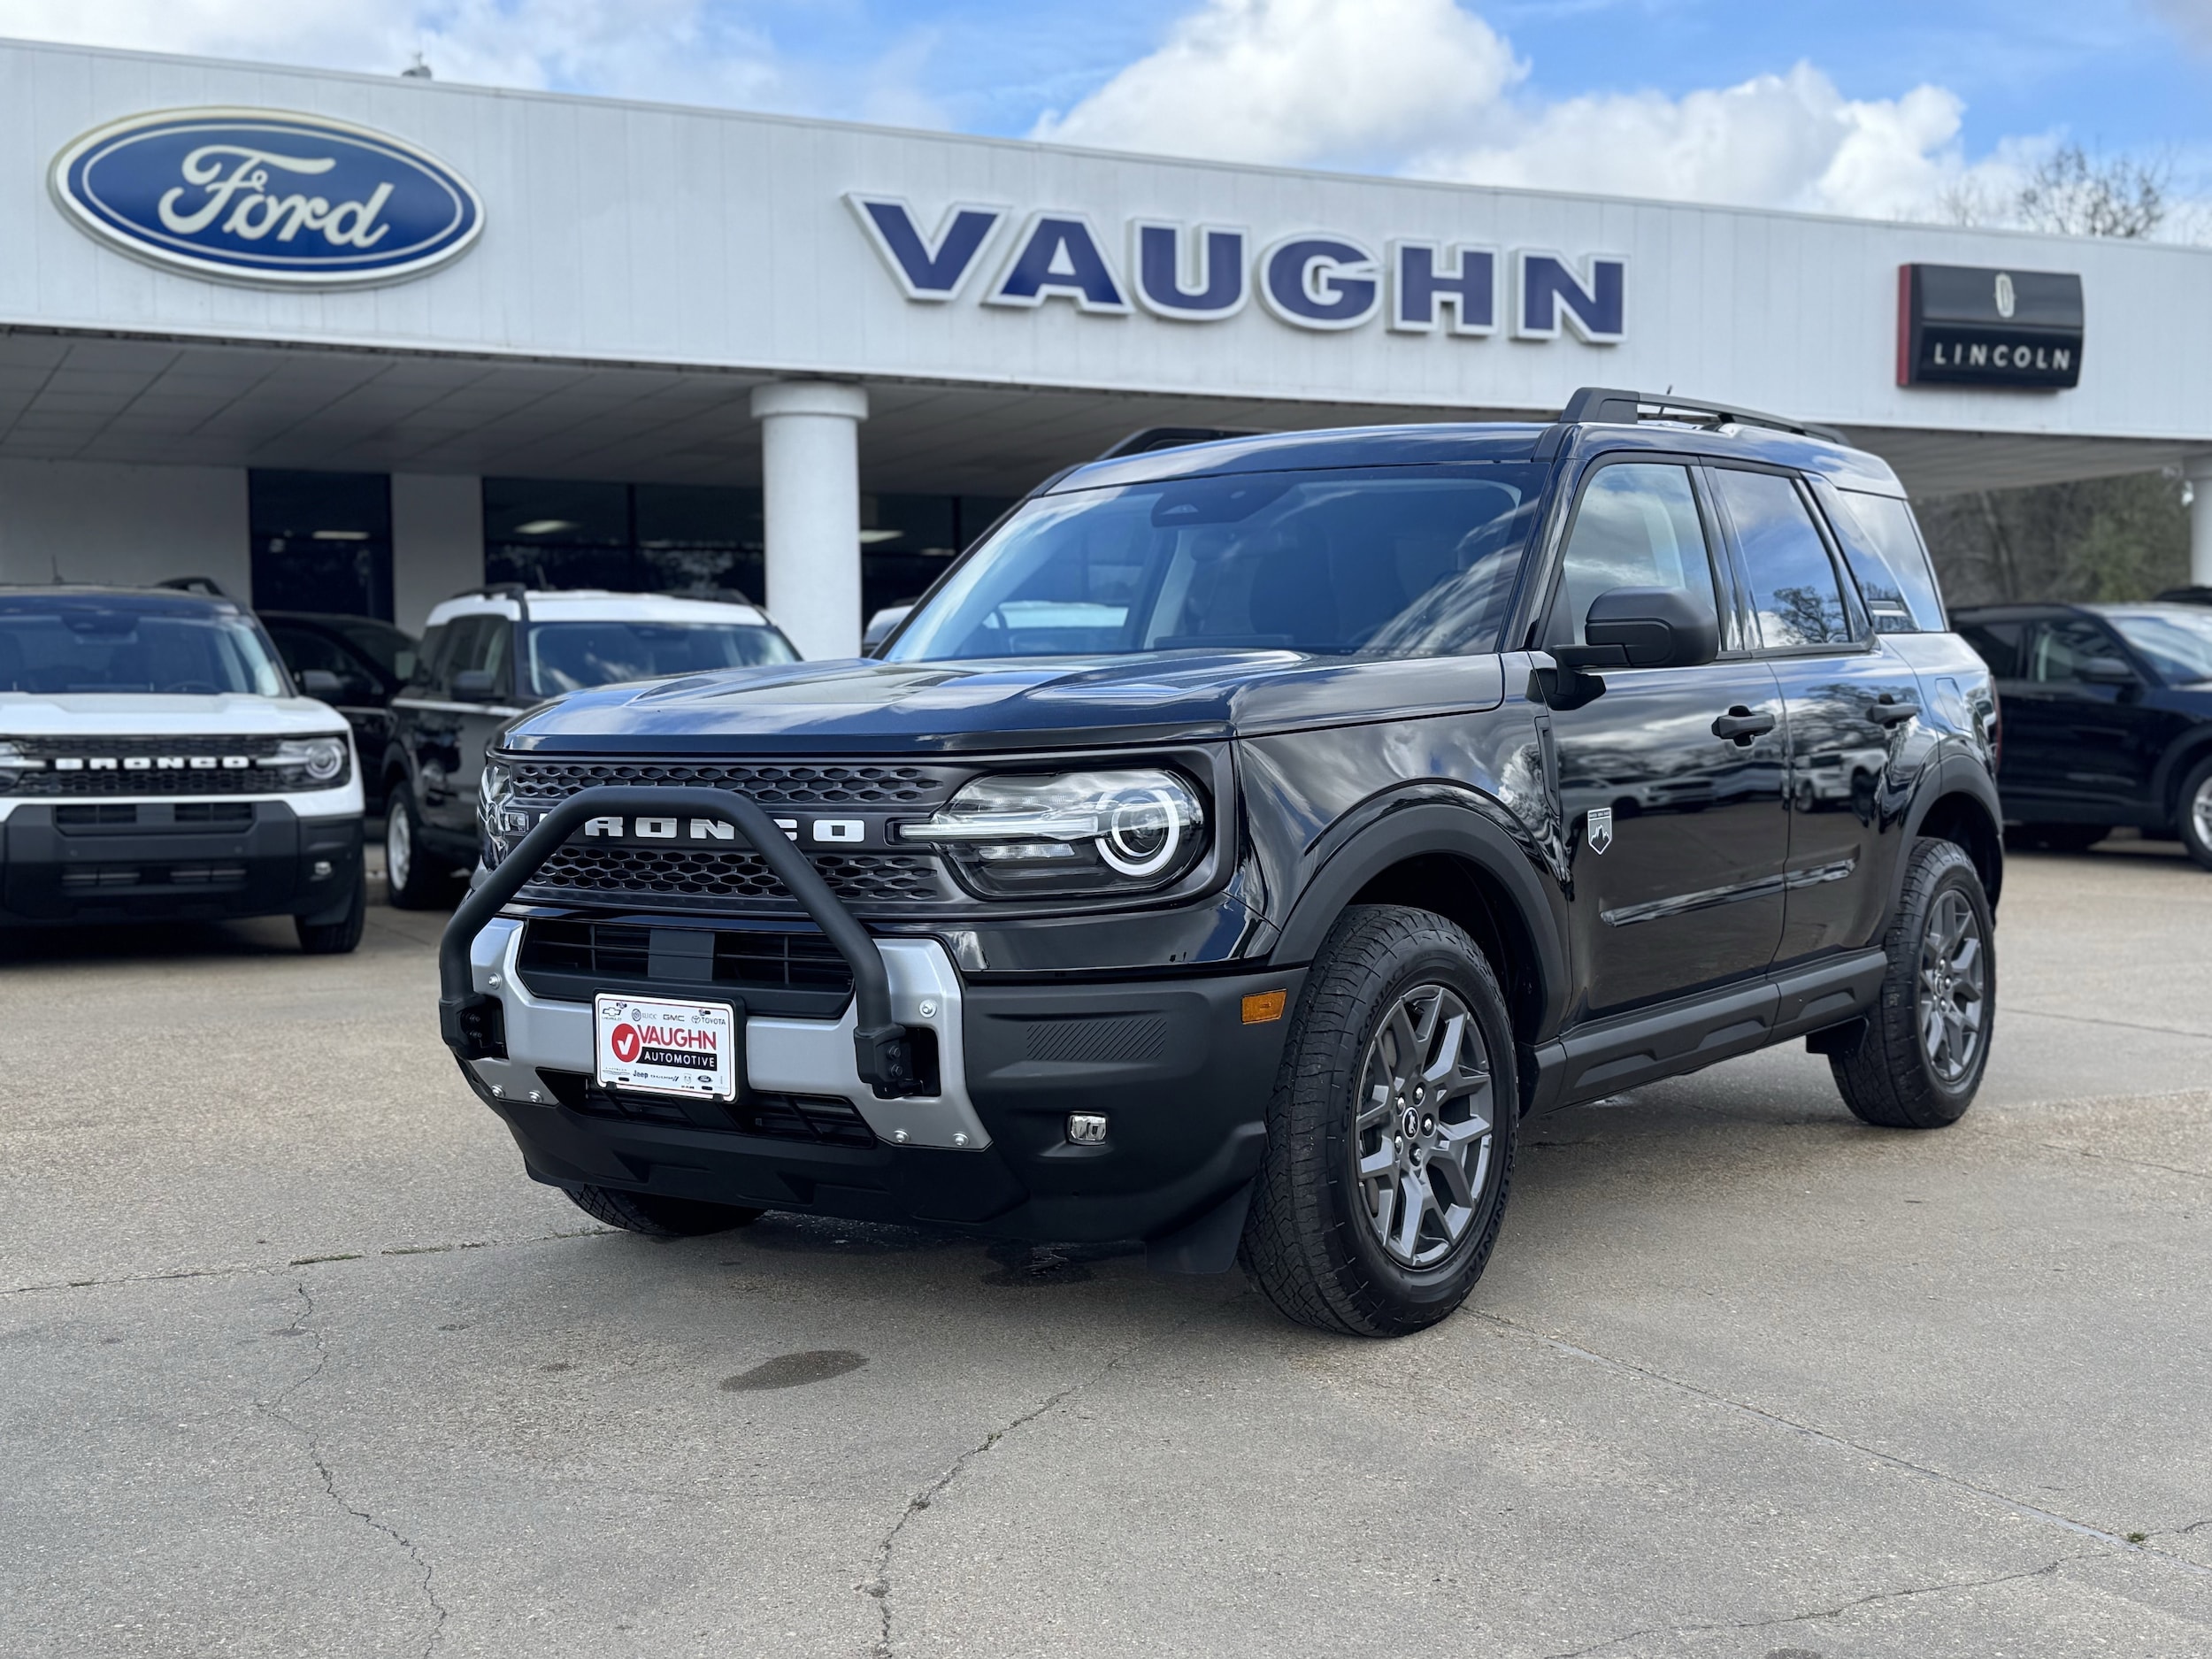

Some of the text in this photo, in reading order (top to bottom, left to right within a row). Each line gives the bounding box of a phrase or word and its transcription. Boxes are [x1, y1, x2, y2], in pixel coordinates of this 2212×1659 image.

[158, 144, 396, 249] Ford
[844, 193, 1629, 343] VAUGHN
[1934, 342, 2071, 372] LINCOLN
[55, 757, 250, 771] BRONCO
[539, 812, 864, 842] RONO
[702, 1017, 726, 1025] TOYOTA
[637, 1025, 717, 1050] VAUGHN
[644, 1050, 715, 1068] AUTOMOTIVE
[633, 1070, 649, 1079] Jeep
